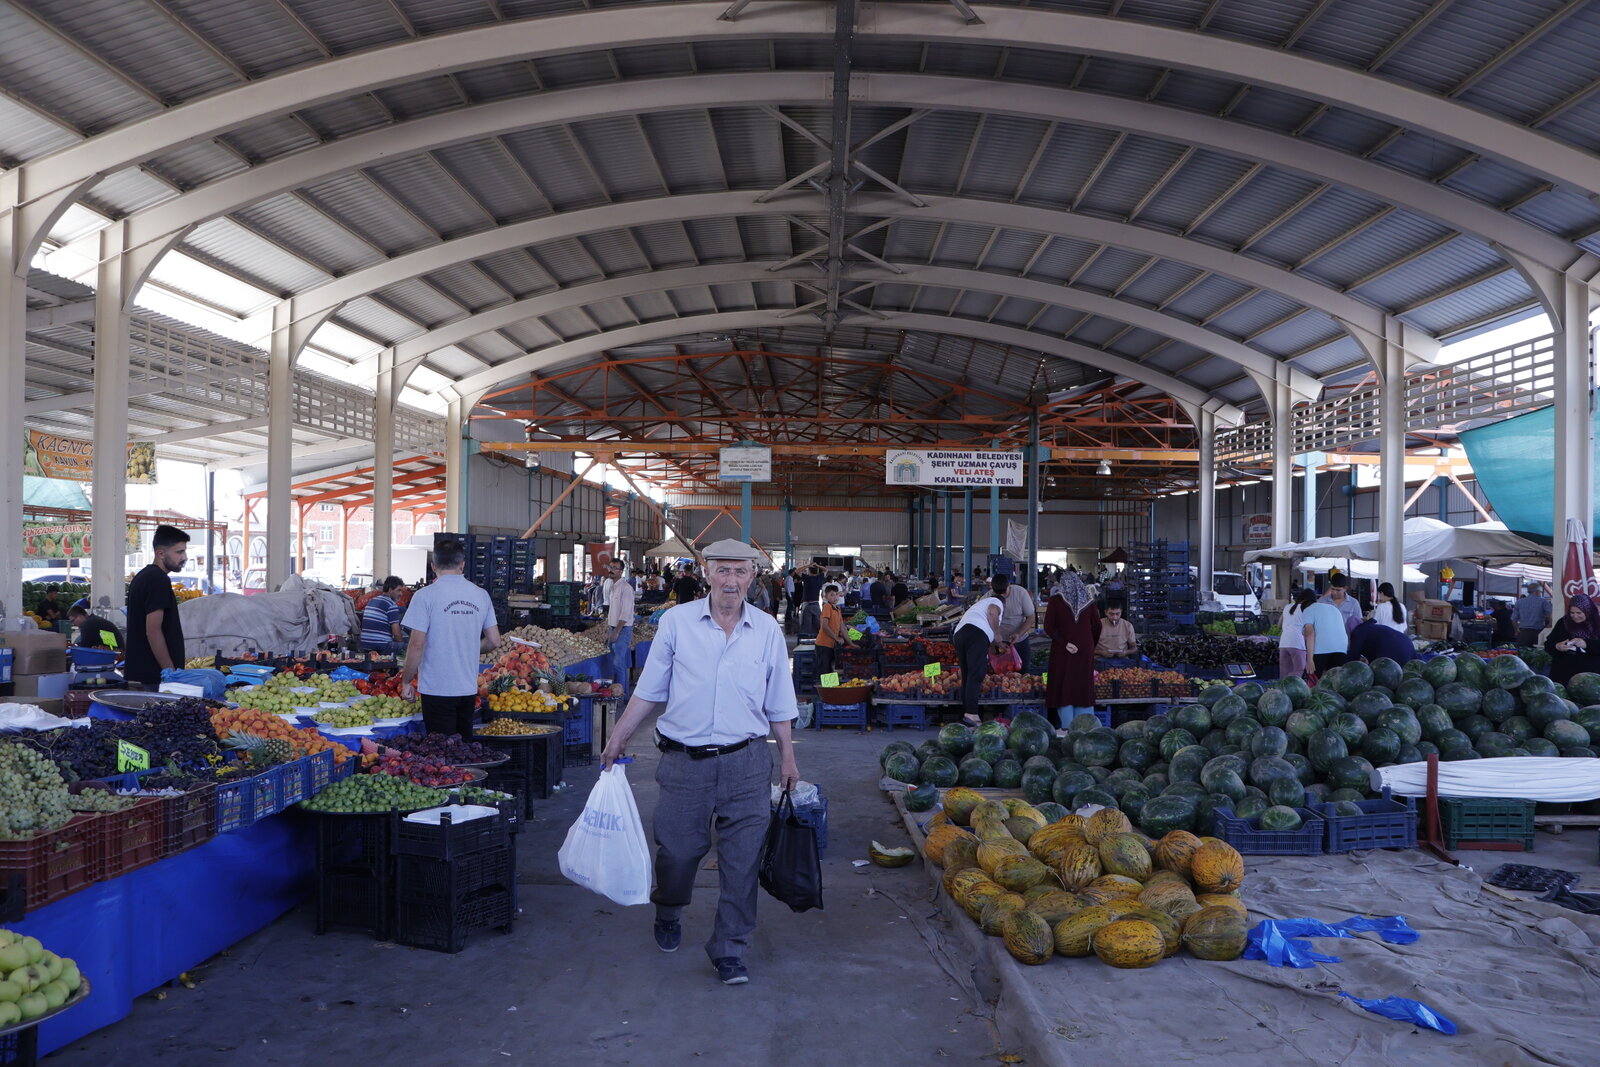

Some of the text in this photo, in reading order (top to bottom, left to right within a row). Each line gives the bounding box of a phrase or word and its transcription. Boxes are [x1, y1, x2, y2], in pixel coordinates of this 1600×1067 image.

[976, 452, 1022, 460] BELEDİYESİ
[931, 460, 955, 469] ŞEHİT
[989, 461, 1017, 470] ÇAVUŞ
[974, 469, 995, 477] ATEŞ
